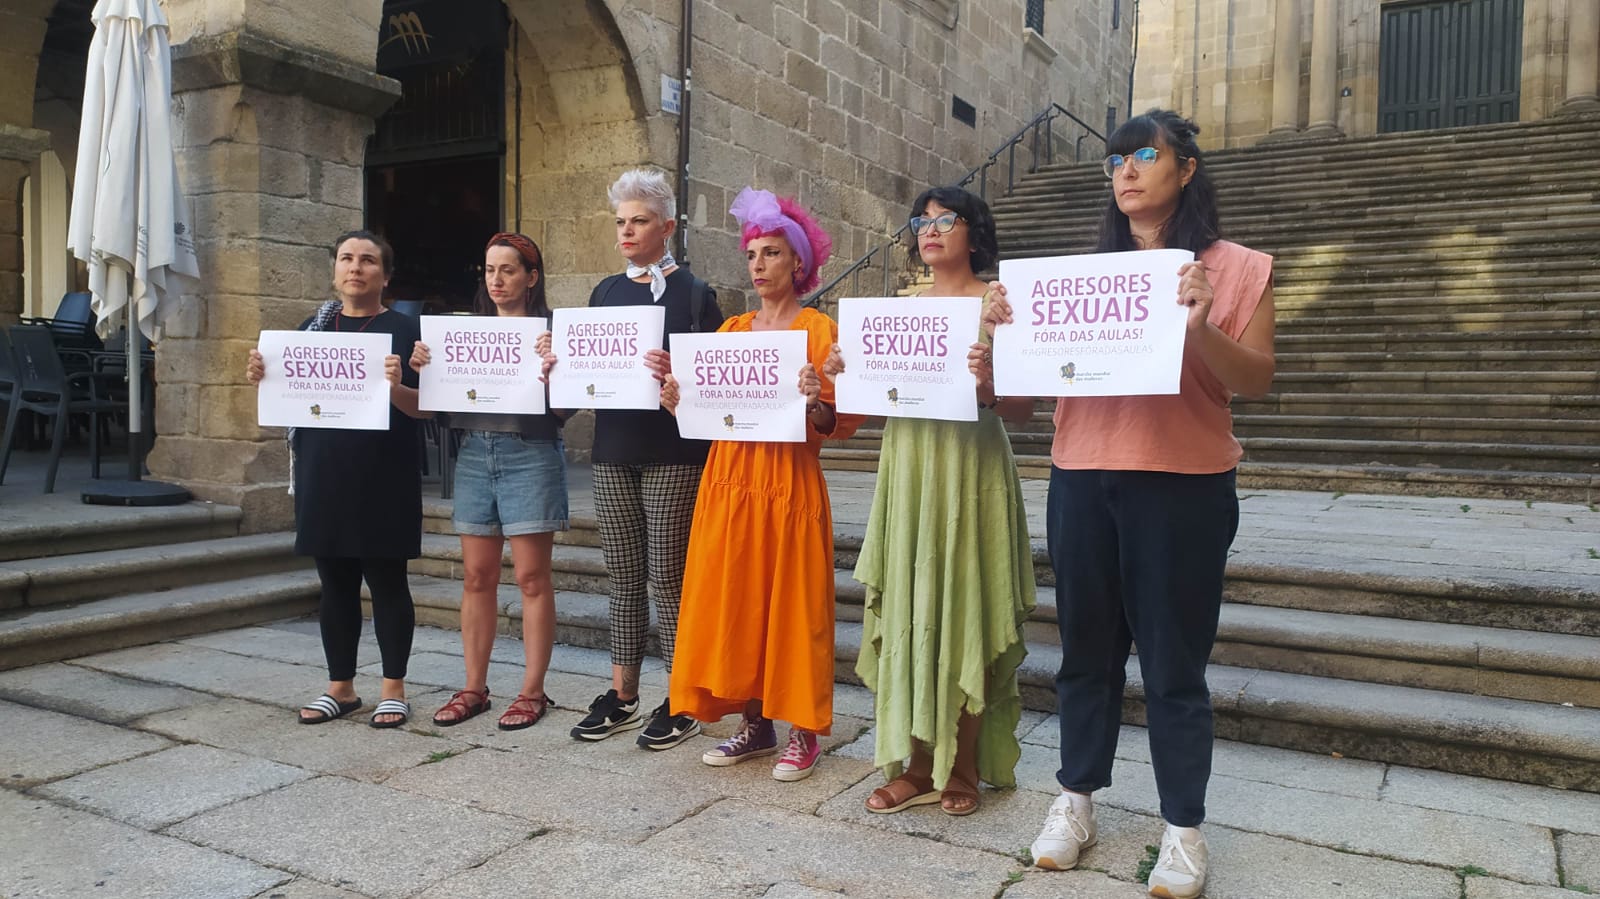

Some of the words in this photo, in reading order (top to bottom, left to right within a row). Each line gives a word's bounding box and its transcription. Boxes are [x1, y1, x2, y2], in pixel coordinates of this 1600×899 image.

[1031, 273, 1151, 298] AGRESORES
[1031, 295, 1149, 326] SEXUAIS
[567, 322, 638, 337] AGRESORES
[861, 316, 949, 332] AGRESORES
[444, 331, 522, 345] AGRESORES
[1034, 329, 1066, 343] FÓRA
[1069, 330, 1094, 342] DAS
[1097, 328, 1144, 341] AULAS!
[568, 338, 638, 357] SEXUAIS
[862, 334, 948, 357] SEXUAIS
[282, 346, 365, 361] AGRESORES
[445, 346, 521, 364] SEXUAIS
[694, 349, 780, 364] AGRESORES
[284, 360, 366, 380] SEXUAIS
[471, 367, 487, 375] DAS
[490, 368, 519, 377] AULAS!
[592, 361, 606, 369] DAS
[608, 361, 635, 369] AULAS!
[866, 359, 890, 370] FÓRA
[892, 361, 909, 371] DAS
[911, 362, 945, 372] AULAS!
[695, 365, 779, 386] SEXUAIS
[289, 381, 311, 390] FÓRA
[314, 382, 331, 391] DAS
[334, 383, 365, 392] AULAS!
[700, 388, 723, 399] FÓRA
[725, 390, 743, 399] DAS
[746, 390, 777, 399] AULAS!
